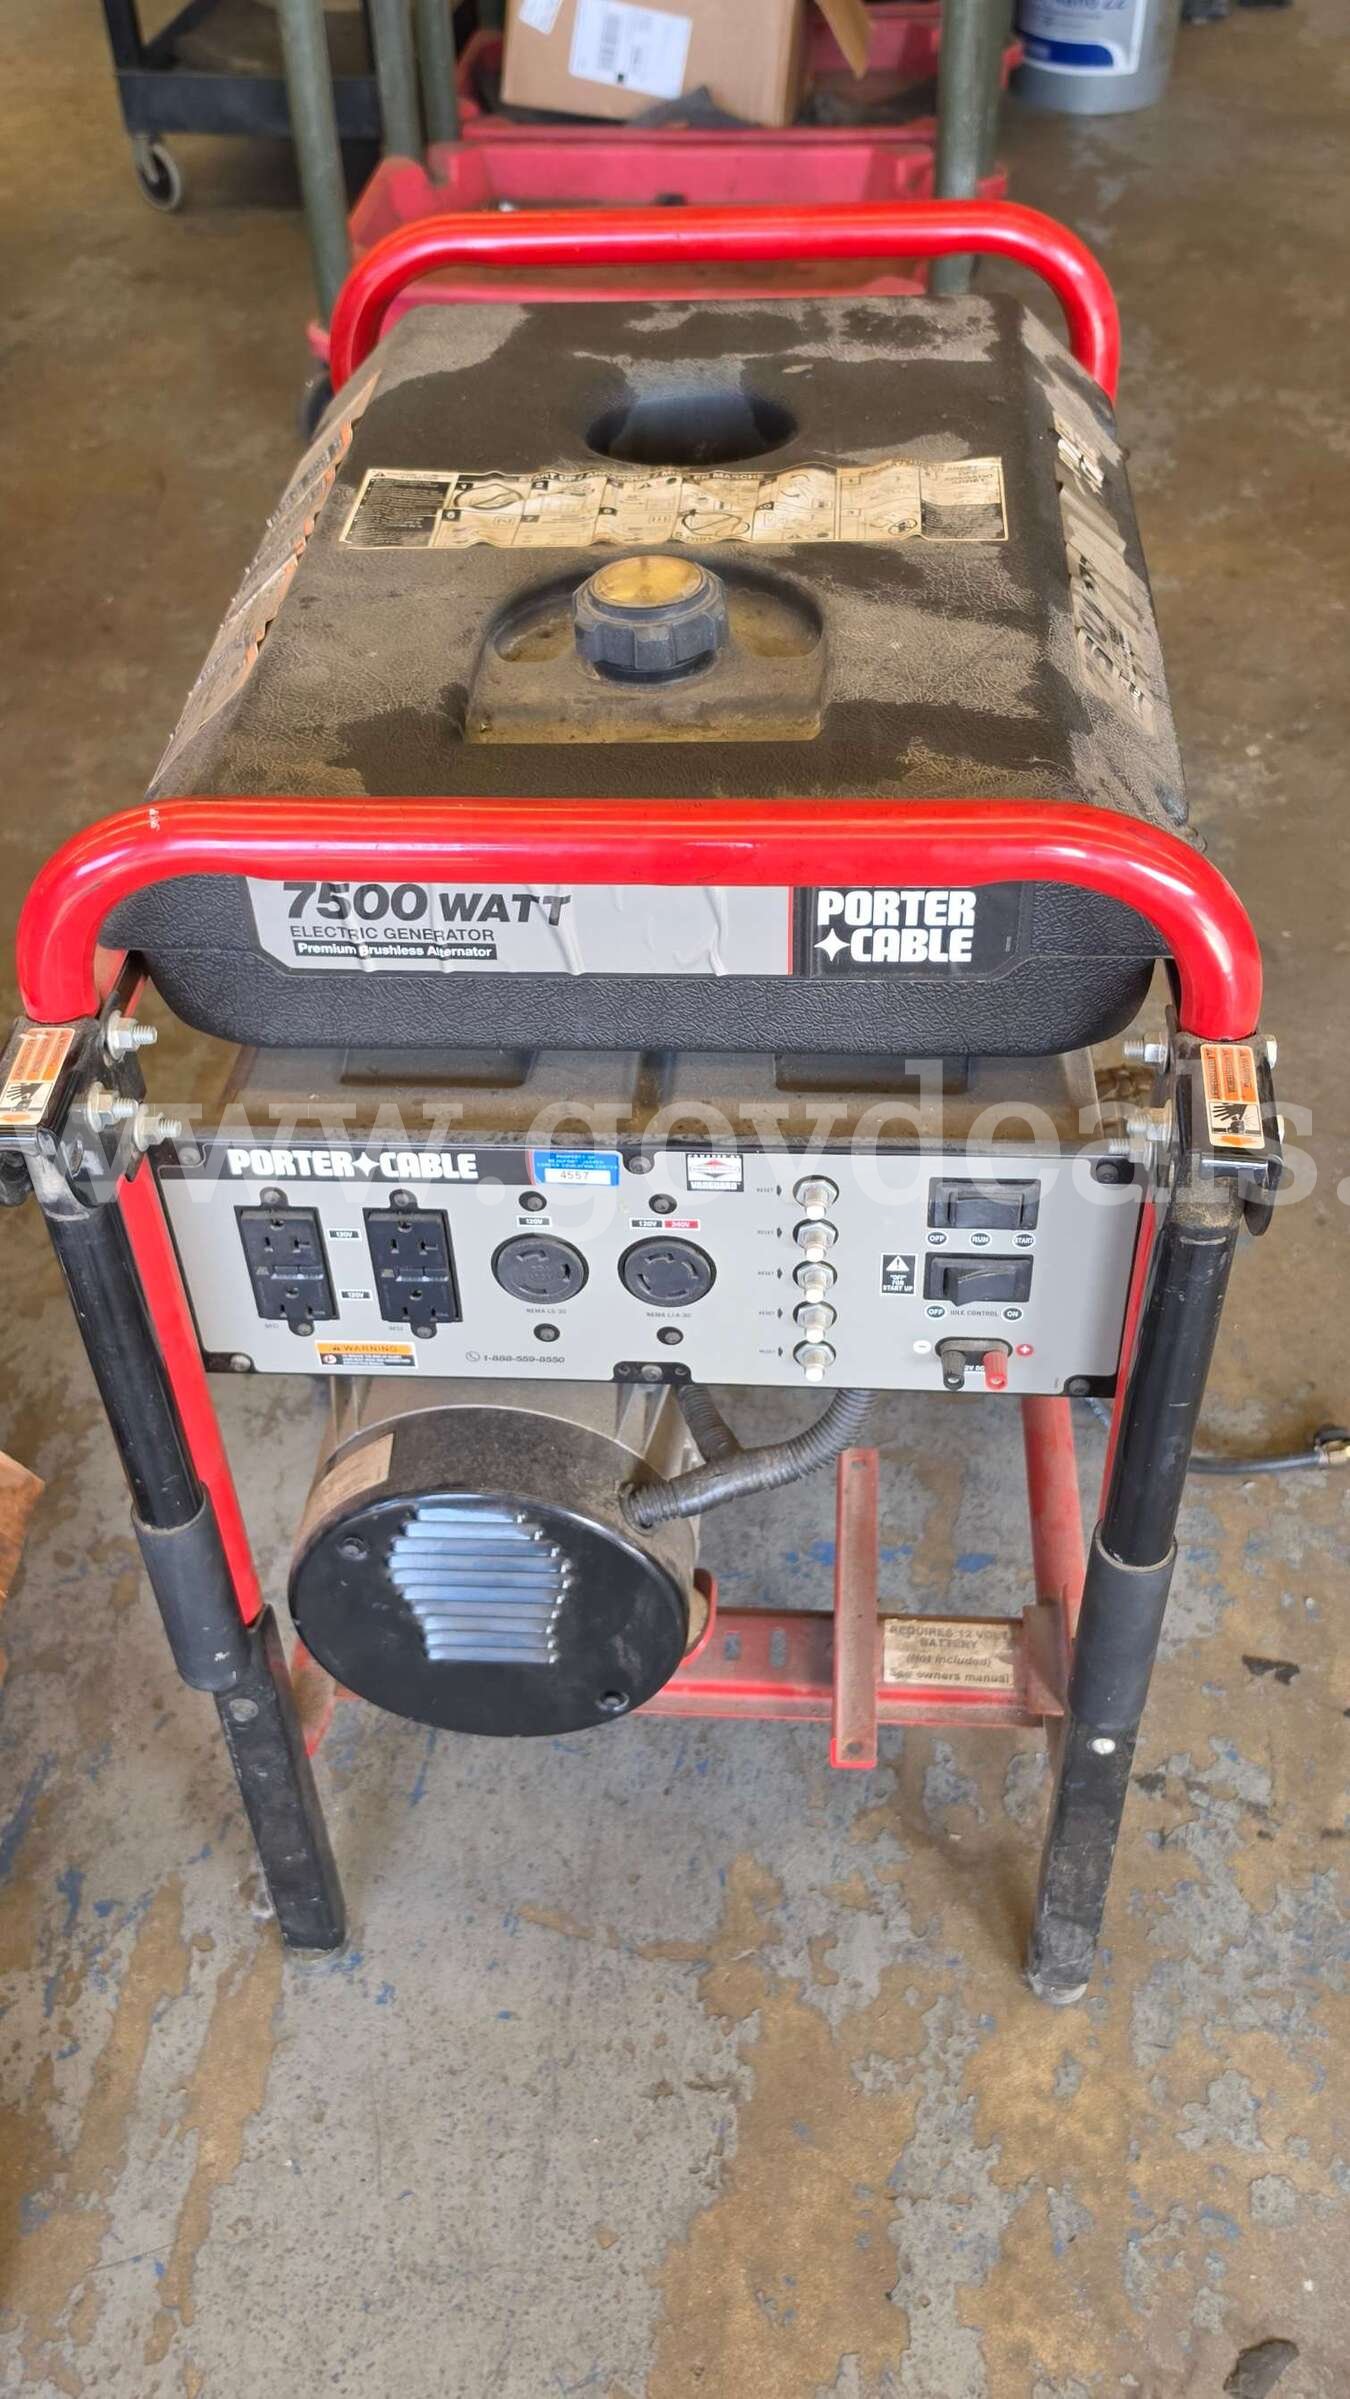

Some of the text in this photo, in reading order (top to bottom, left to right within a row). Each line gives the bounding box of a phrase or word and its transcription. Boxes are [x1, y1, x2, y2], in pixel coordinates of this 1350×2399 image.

[282, 882, 571, 926] 7500 WATT
[817, 890, 977, 927] PORTER
[290, 925, 495, 943] ELECTRIC GENERATOR
[297, 942, 493, 958] Premium Brushless Alternator
[850, 928, 975, 963] CABLE
[227, 1149, 479, 1179] PORTER CABLE
[560, 1171, 589, 1180] 4557
[929, 1235, 945, 1243] OFF
[1014, 1237, 1034, 1245] START
[928, 1308, 944, 1316] OFF
[1006, 1310, 1019, 1318] ON
[889, 1625, 954, 1639] REQUIRES
[958, 1629, 973, 1639] 12
[919, 1637, 977, 1648] BATTERY
[934, 1654, 992, 1667] included)
[917, 1671, 961, 1681] owners
[964, 1672, 1010, 1684] manual
